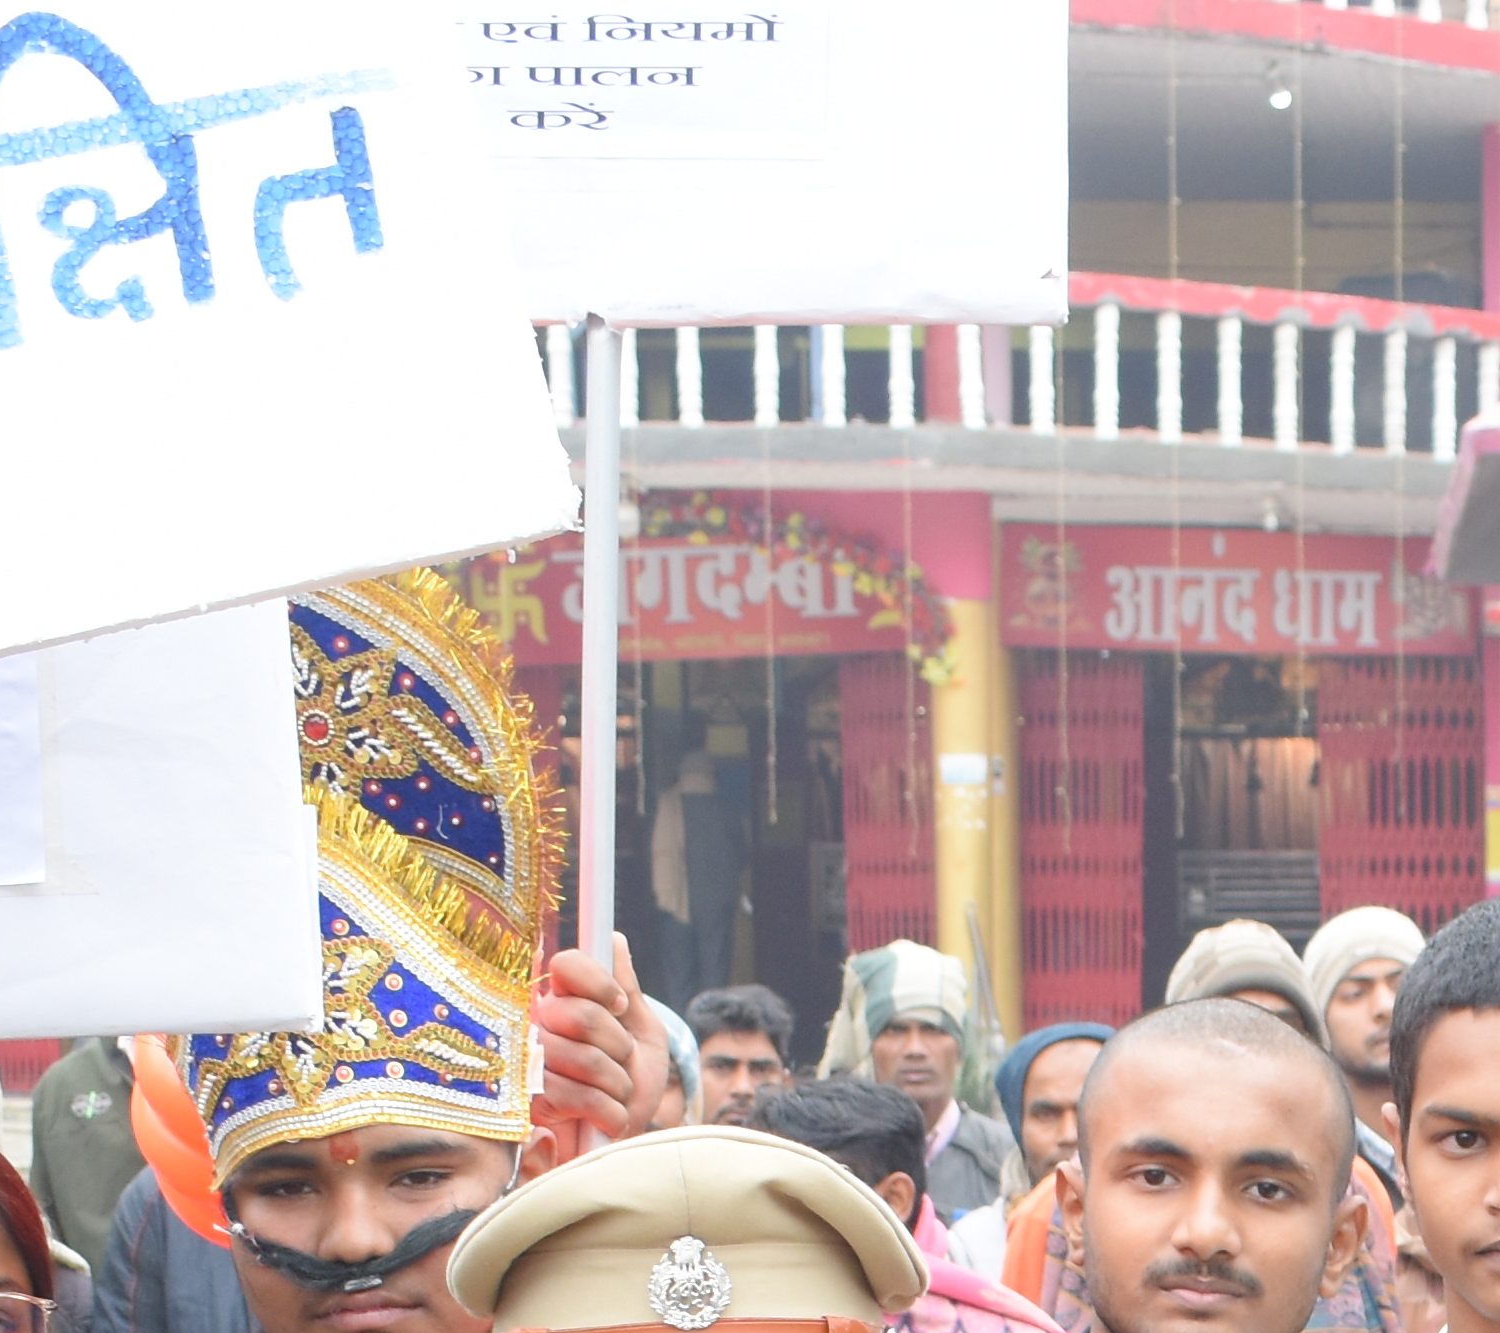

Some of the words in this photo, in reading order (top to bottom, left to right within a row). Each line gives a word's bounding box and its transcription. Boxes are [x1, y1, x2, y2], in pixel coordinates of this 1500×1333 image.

[477, 14, 569, 44] एवं
[583, 13, 786, 44] नियमों
[524, 65, 704, 88] पालन
[506, 101, 615, 131] करें
[1104, 533, 1262, 645] आनंद
[1272, 567, 1384, 649] धाम
